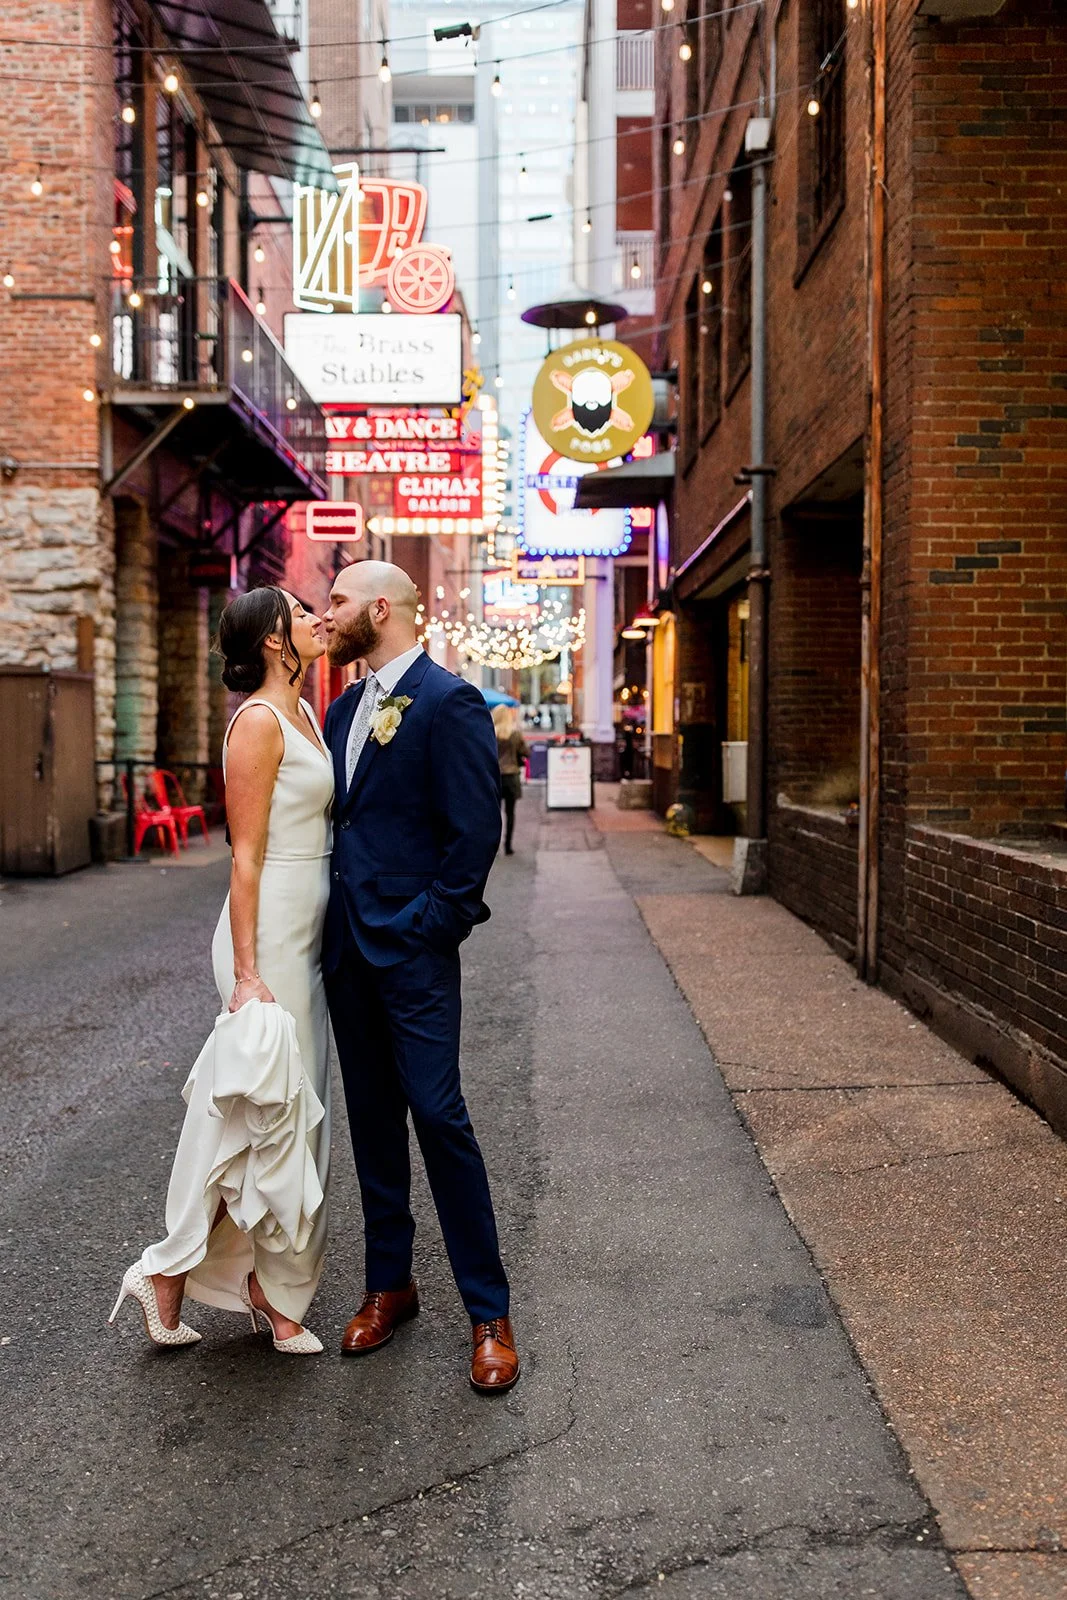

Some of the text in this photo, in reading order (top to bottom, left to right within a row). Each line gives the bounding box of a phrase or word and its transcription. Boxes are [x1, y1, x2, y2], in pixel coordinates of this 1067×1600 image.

[358, 332, 435, 354] Brass
[320, 362, 425, 385] Stables
[353, 417, 372, 438] &
[375, 418, 458, 438] DANCE
[398, 477, 480, 496] CLIMAX
[408, 498, 471, 512] SALOON
